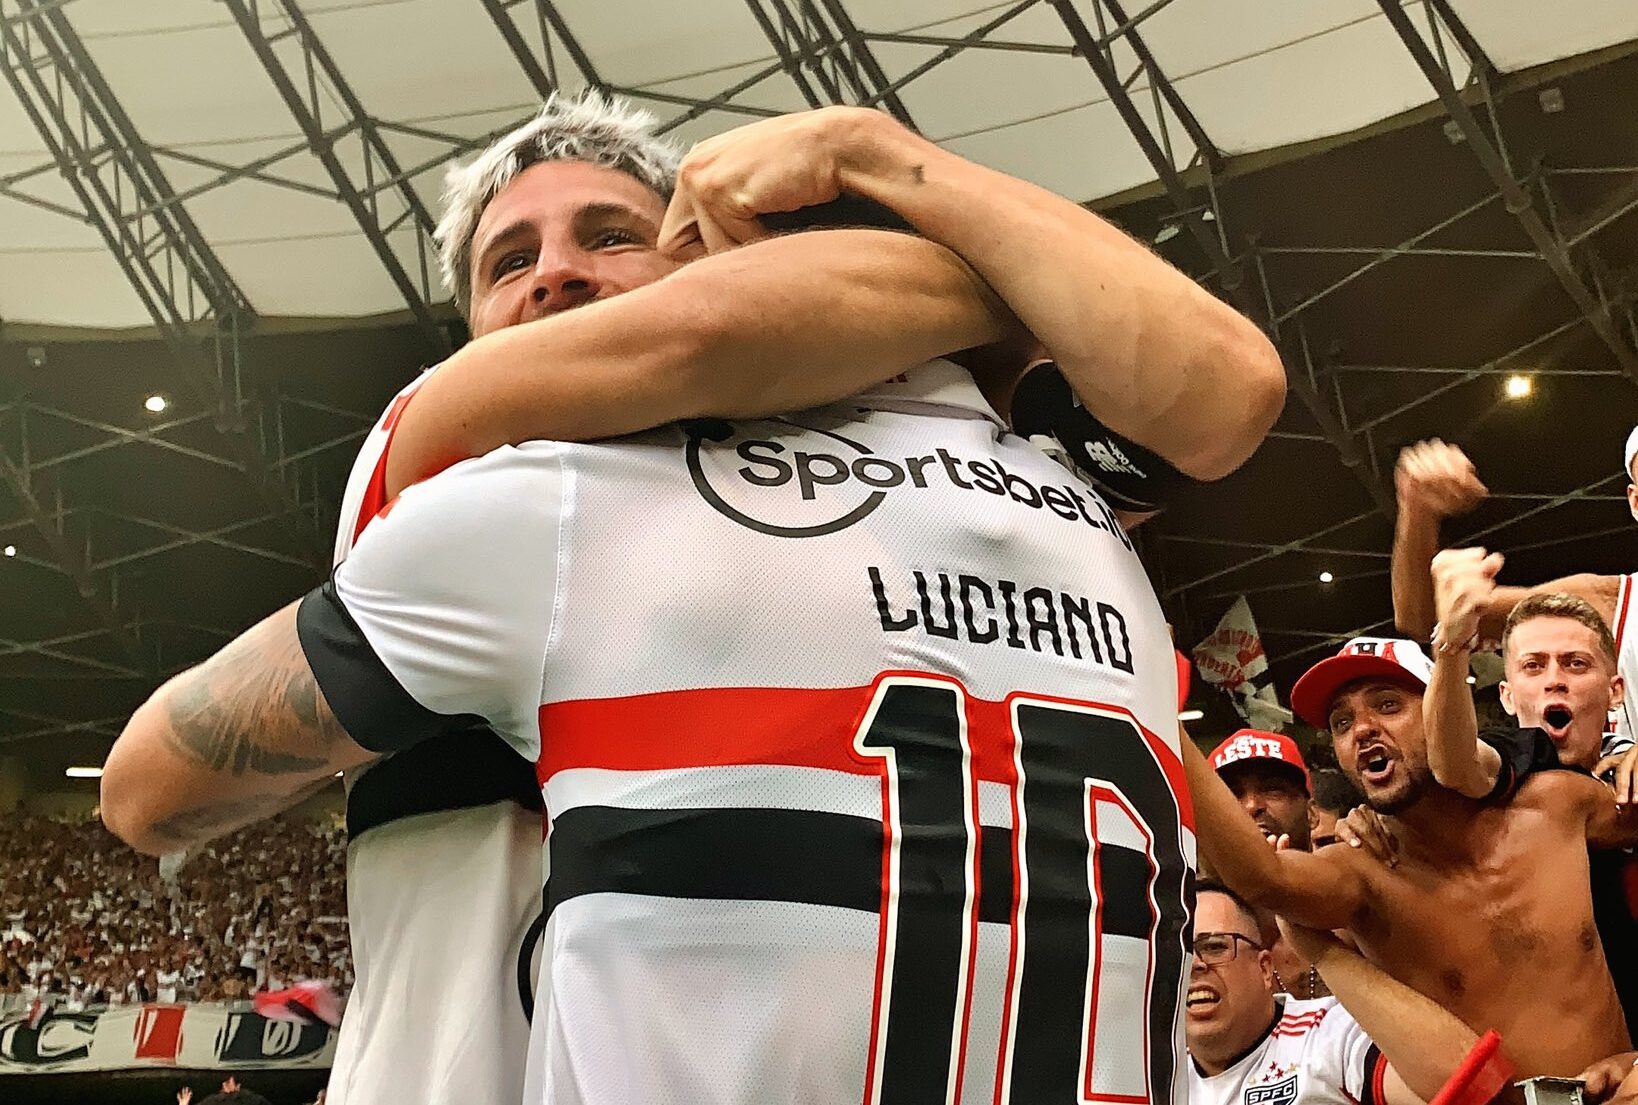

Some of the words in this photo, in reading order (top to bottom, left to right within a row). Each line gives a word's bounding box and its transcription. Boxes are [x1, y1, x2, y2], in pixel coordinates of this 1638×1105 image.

[868, 566, 1135, 676] LUCIANO
[1214, 735, 1284, 768] LESTE
[849, 671, 1190, 1105] 10
[1249, 1083, 1293, 1104] SPFC
